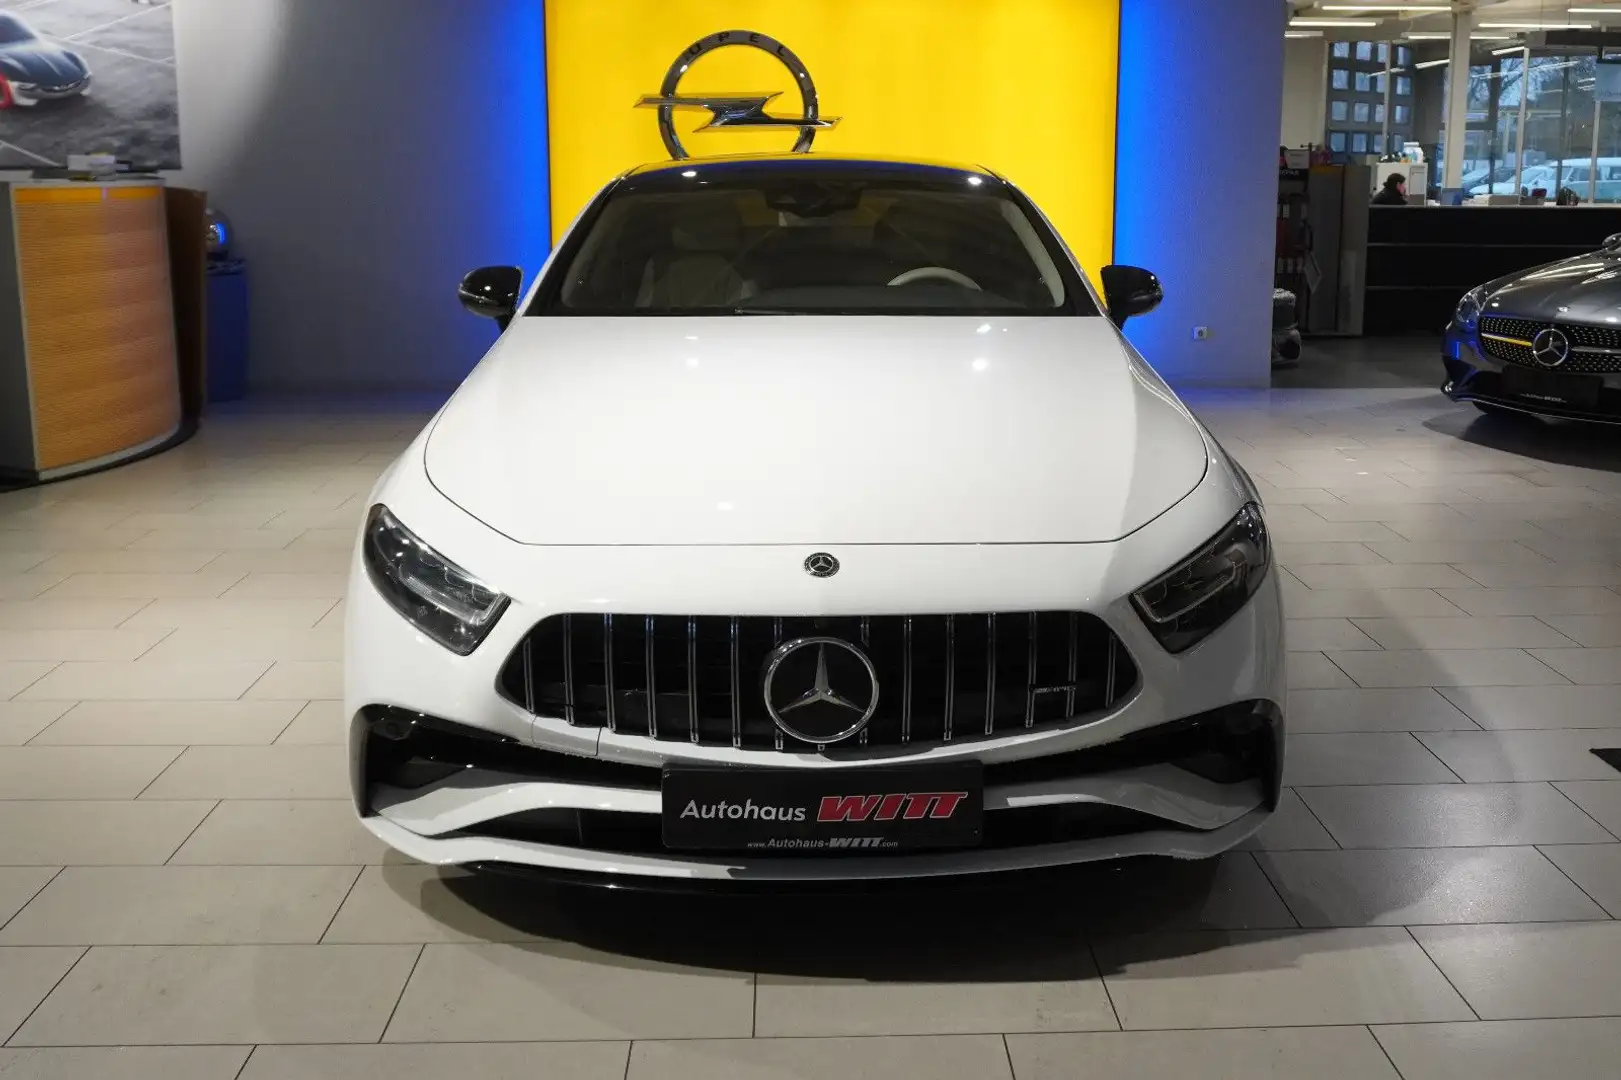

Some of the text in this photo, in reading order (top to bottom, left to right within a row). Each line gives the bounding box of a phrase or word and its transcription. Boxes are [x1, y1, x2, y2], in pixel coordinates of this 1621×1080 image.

[689, 31, 788, 57] OPEL
[679, 791, 969, 823] Autohaus WITT
[747, 837, 899, 849] www.Autohaus-WITT.com
